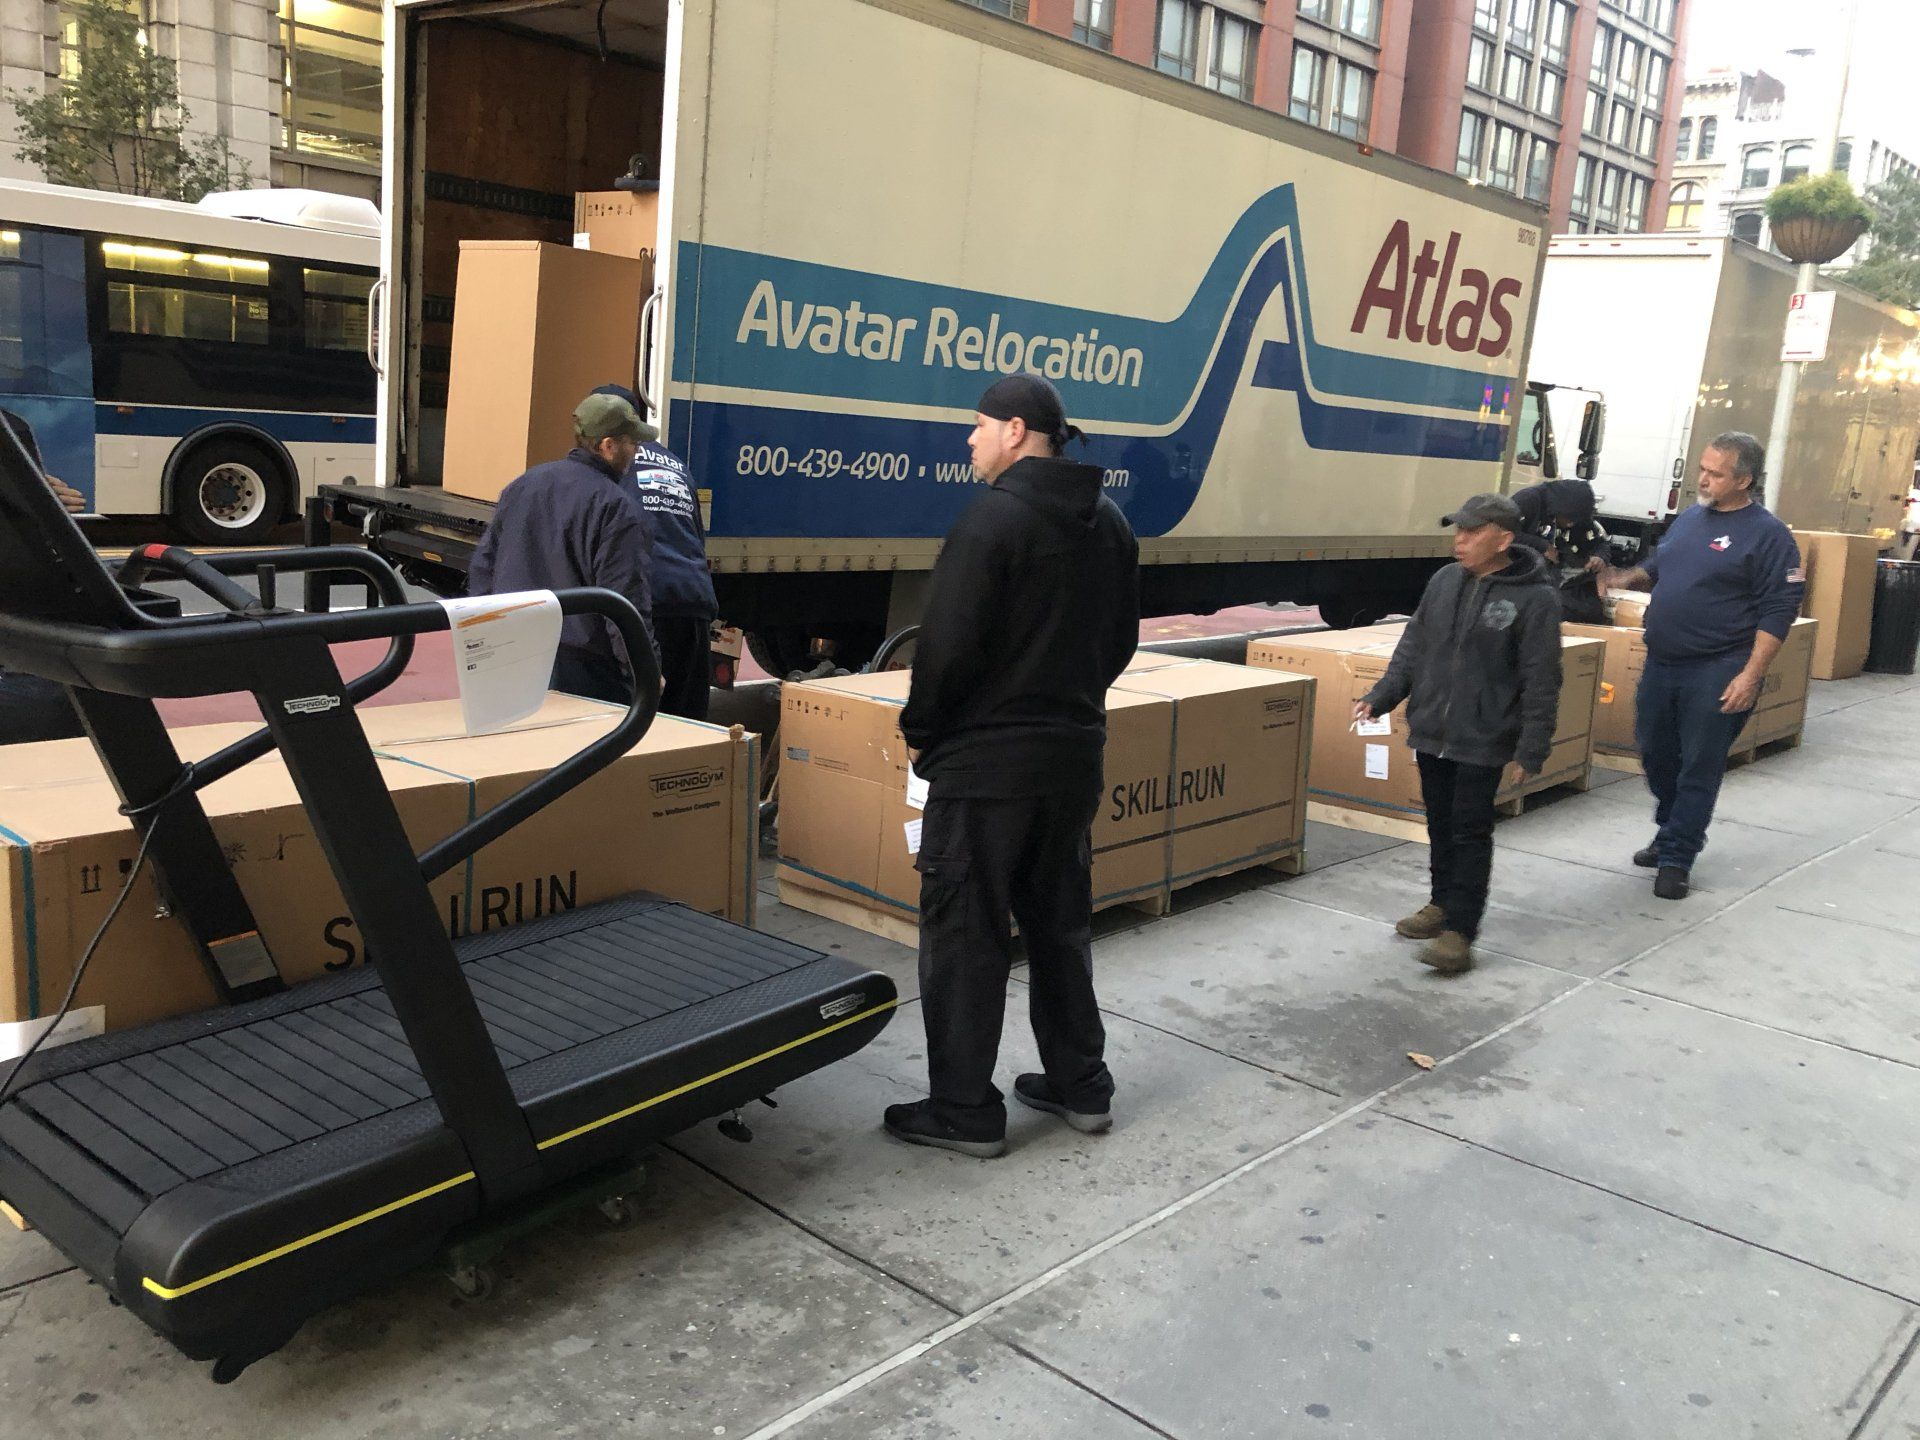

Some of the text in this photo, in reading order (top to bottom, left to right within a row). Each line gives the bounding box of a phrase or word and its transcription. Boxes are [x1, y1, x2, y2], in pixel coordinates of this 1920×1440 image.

[1350, 218, 1523, 358] Atlas
[735, 279, 1144, 388] Avatar Relocation
[634, 445, 685, 472] Avatar
[736, 444, 911, 481] 800-439-4900
[649, 771, 724, 793] TECHNOGYM
[1111, 763, 1226, 822] SKILLRUN
